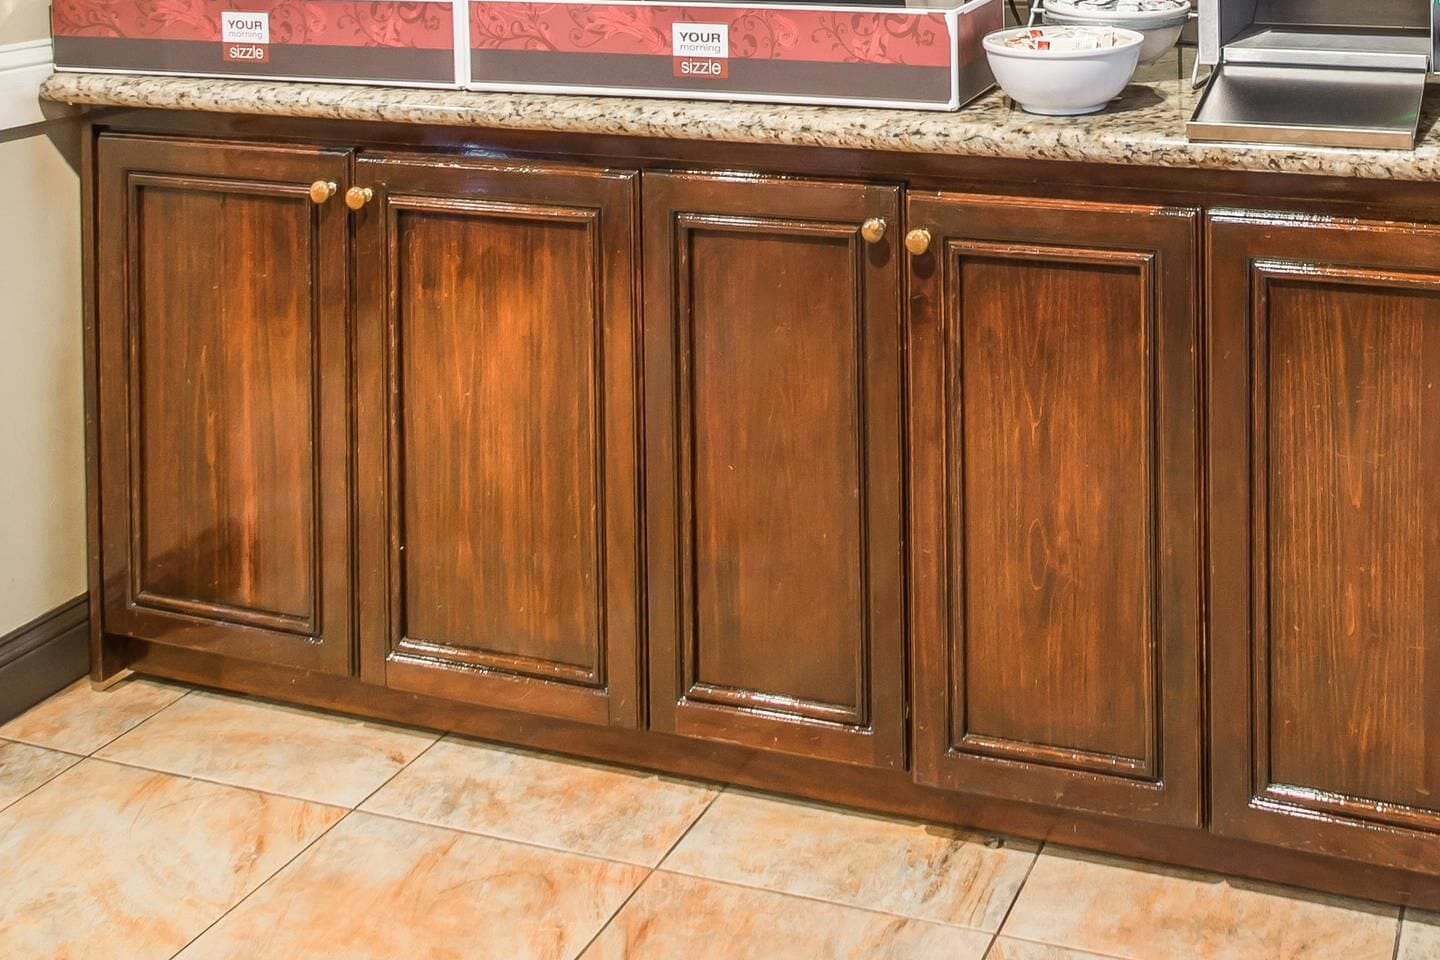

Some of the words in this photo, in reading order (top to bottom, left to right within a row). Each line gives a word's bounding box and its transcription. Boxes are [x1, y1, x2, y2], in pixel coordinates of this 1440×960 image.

[227, 19, 263, 31] YOUR
[228, 31, 264, 41] morning
[679, 31, 721, 43] YOUR
[229, 43, 265, 60] sizzle
[679, 44, 721, 54] morning
[681, 57, 722, 75] sizzle
